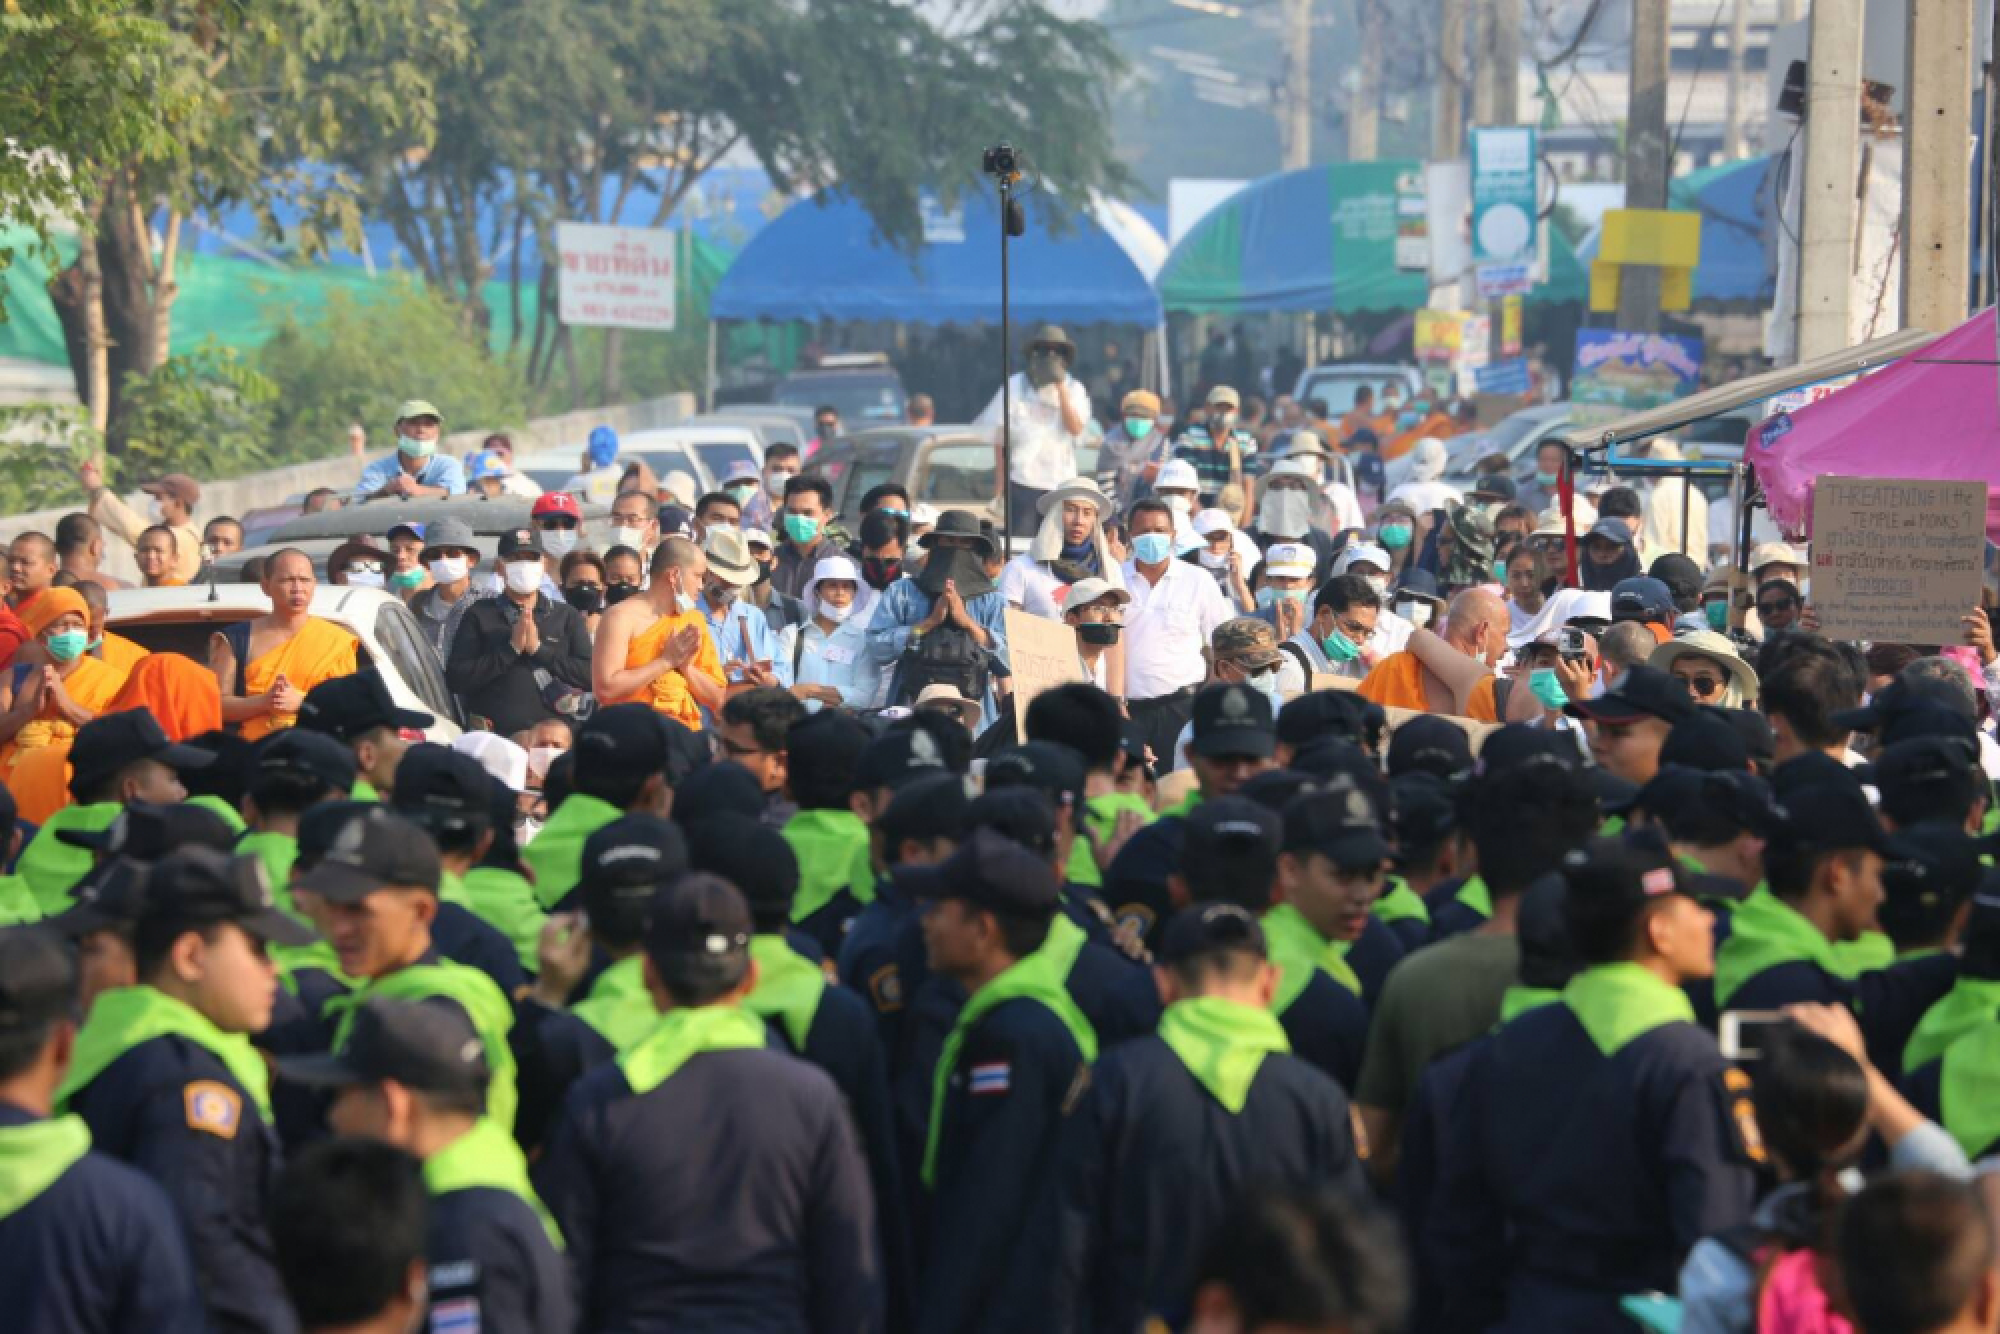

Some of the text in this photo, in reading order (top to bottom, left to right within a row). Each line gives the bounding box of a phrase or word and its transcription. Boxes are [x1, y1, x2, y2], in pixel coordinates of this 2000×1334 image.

[1826, 483, 1937, 509] THREATENING
[1849, 510, 1900, 529] TEMPLE
[1919, 511, 1960, 530] MONKS
